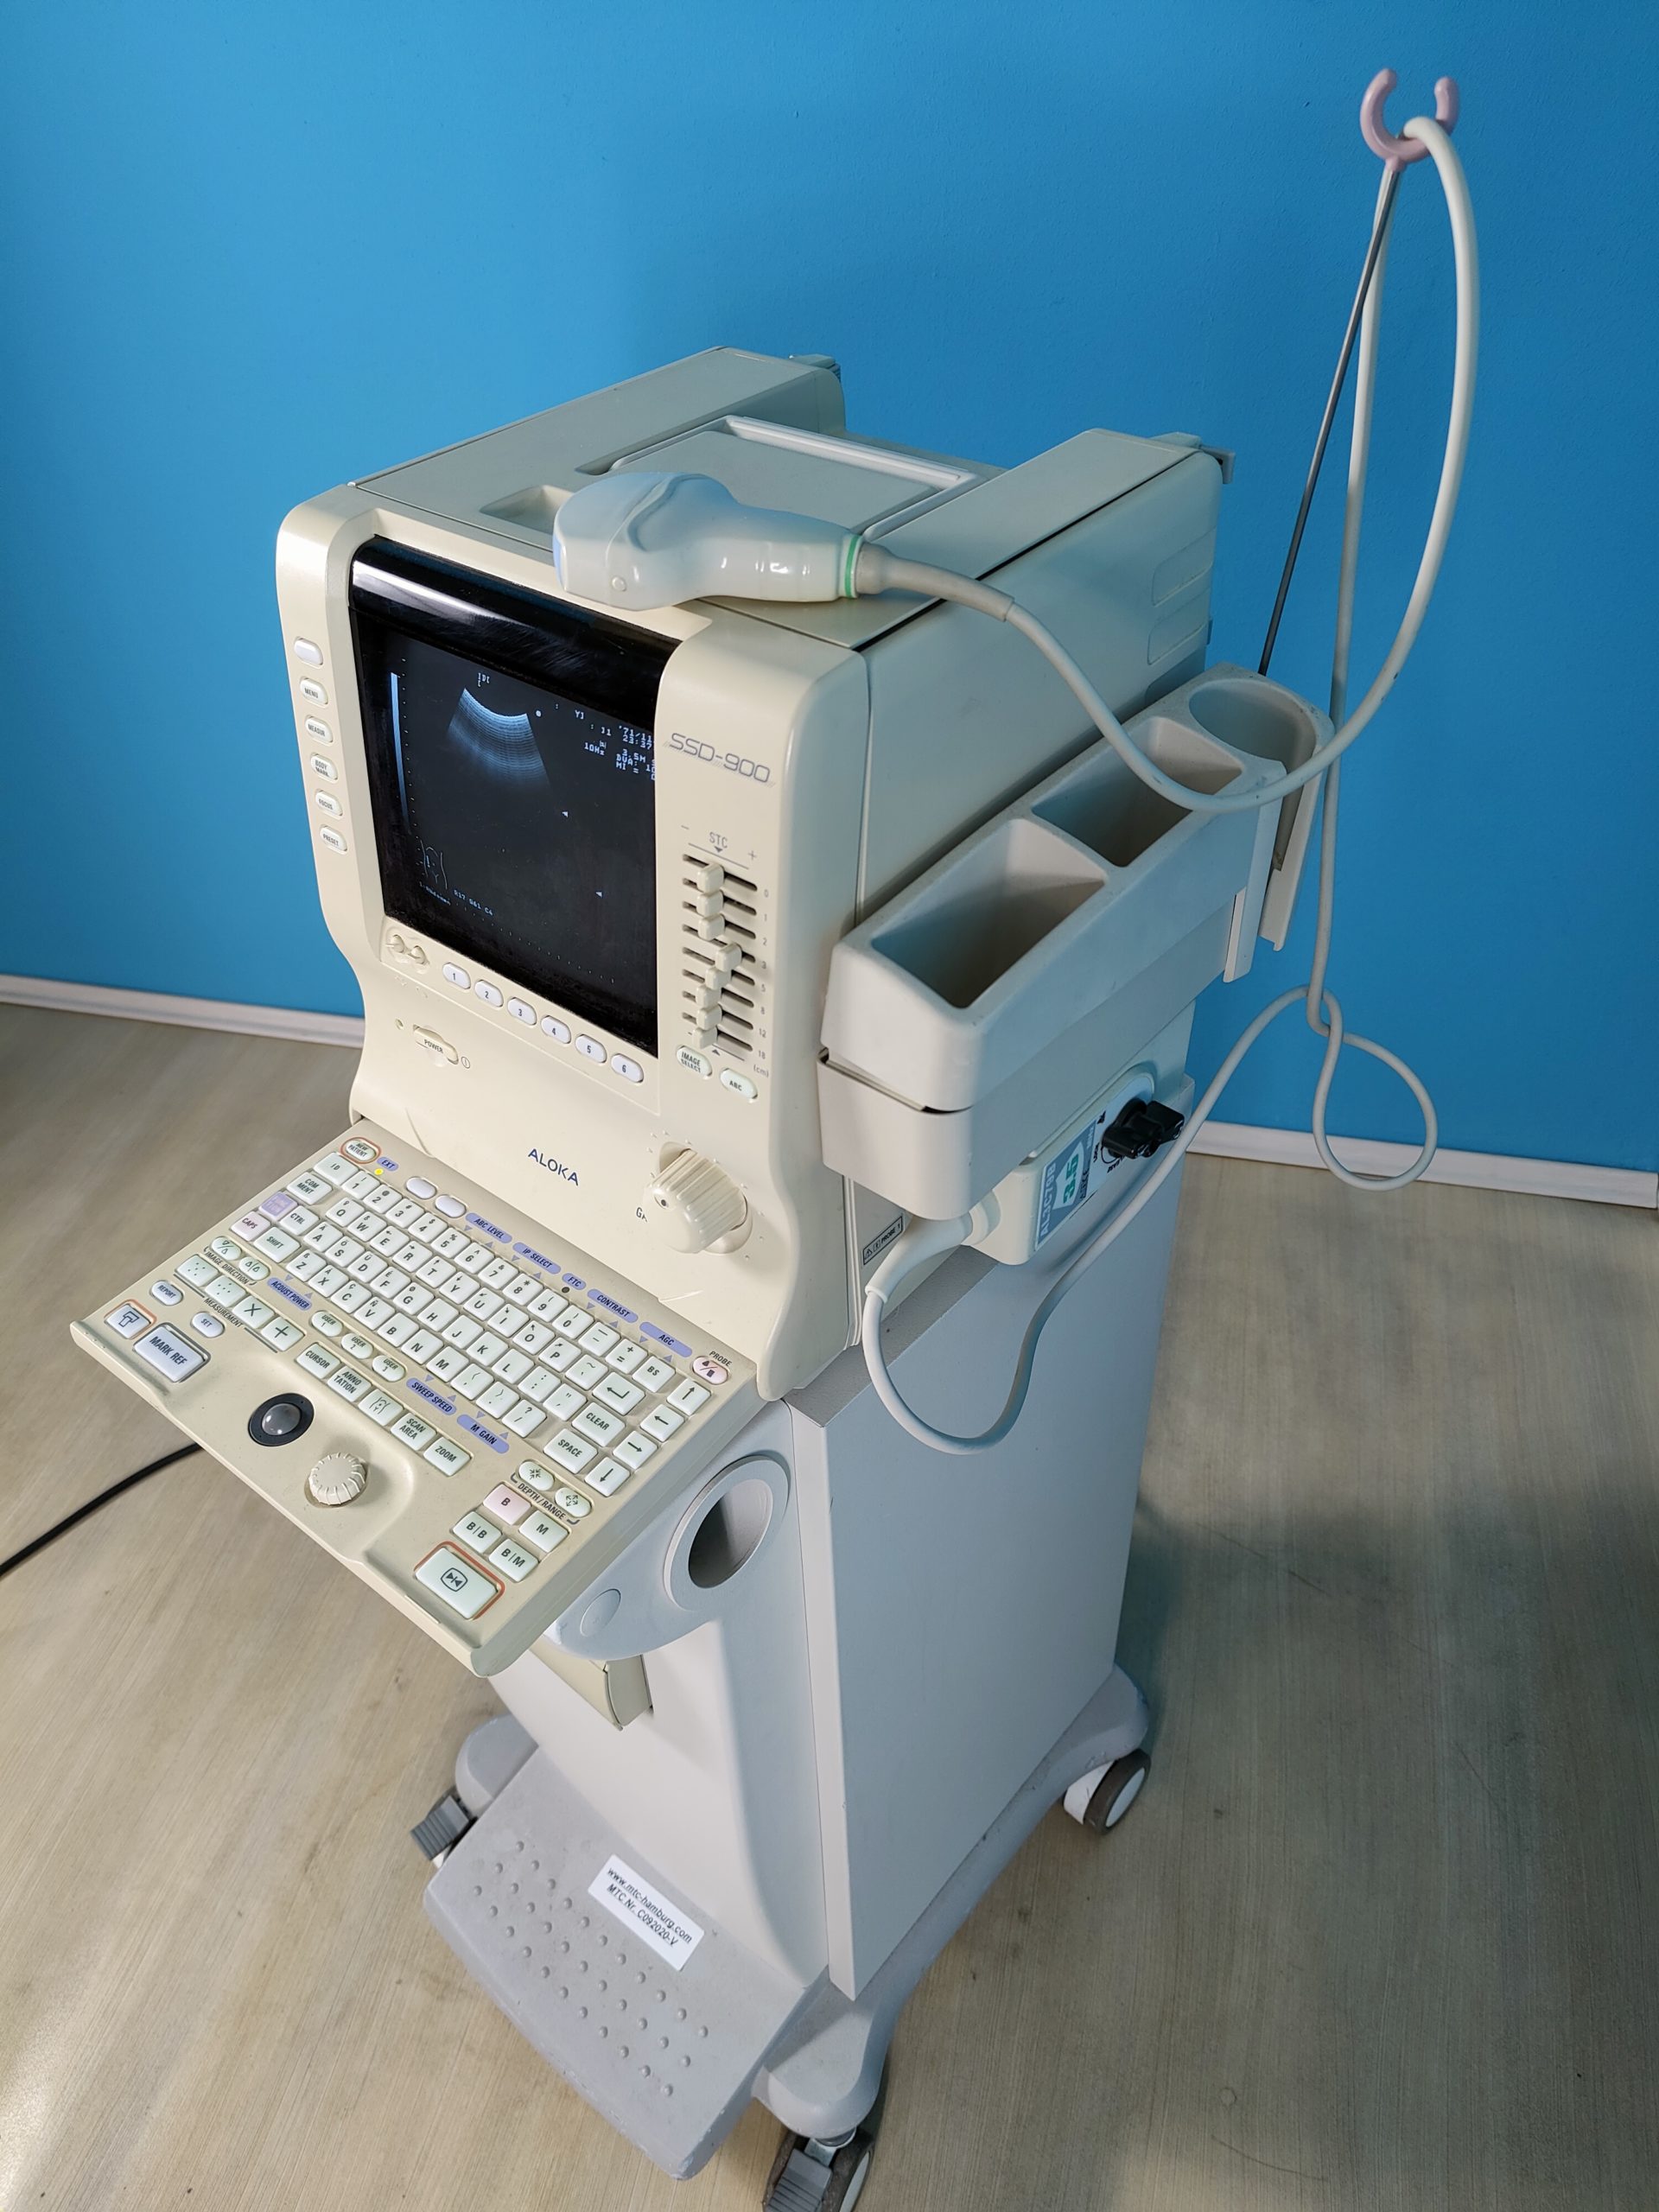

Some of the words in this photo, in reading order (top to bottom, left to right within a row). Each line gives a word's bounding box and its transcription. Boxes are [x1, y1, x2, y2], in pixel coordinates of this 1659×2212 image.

[669, 733, 771, 783] SSD-900
[709, 831, 728, 849] STC
[424, 1039, 444, 1054] POWER
[680, 1058, 702, 1074] SELECT
[681, 1051, 701, 1067] IMAGE
[728, 1079, 742, 1091] ABC
[348, 1144, 368, 1158] PATIENT
[381, 1160, 395, 1170] EXT
[528, 1147, 579, 1186] ALOKA
[296, 1182, 314, 1194] MENT
[304, 1178, 320, 1190] COM
[241, 1217, 258, 1229] CAPS
[474, 1217, 489, 1229] ABC
[486, 1226, 505, 1239] LEVEL
[266, 1236, 284, 1249] SHIFT
[206, 1251, 220, 1266] IMAGE
[221, 1261, 249, 1285] DIRECTION
[530, 1253, 553, 1268] SELECT
[568, 1276, 582, 1287] FTC
[157, 1285, 177, 1299] REPORT
[270, 1281, 292, 1298] ACOUST
[289, 1292, 310, 1309] POWER
[204, 1298, 244, 1328] MEASUREMENT
[596, 1294, 631, 1318] CONTRAST
[200, 1318, 213, 1328] SET
[321, 1314, 337, 1325] USER
[351, 1336, 366, 1348] USER
[658, 1334, 675, 1345] AGC
[149, 1336, 175, 1356] MARK
[169, 1351, 188, 1365] REF
[305, 1350, 330, 1370] CURSOR
[383, 1358, 399, 1370] USER
[709, 1351, 733, 1367] PROBE
[341, 1371, 362, 1386] ANNO
[646, 1365, 660, 1376] BS
[334, 1375, 357, 1394] TATION
[411, 1382, 435, 1398] SWEEP
[431, 1396, 453, 1413] SPEED
[406, 1418, 426, 1433] SCAN
[586, 1412, 610, 1431] CLEAR
[399, 1423, 418, 1440] AREA
[470, 1423, 480, 1433] M
[479, 1430, 498, 1445] GAIN
[435, 1445, 457, 1463] ZOOM
[557, 1439, 582, 1458] SPACE
[500, 1497, 511, 1506] B
[536, 1523, 550, 1535] M
[607, 1867, 692, 1943] www.mtc-hamburg.com
[607, 1883, 626, 1901] MTC
[625, 1898, 637, 1913] Nr.
[637, 1909, 678, 1947] C092020-V
